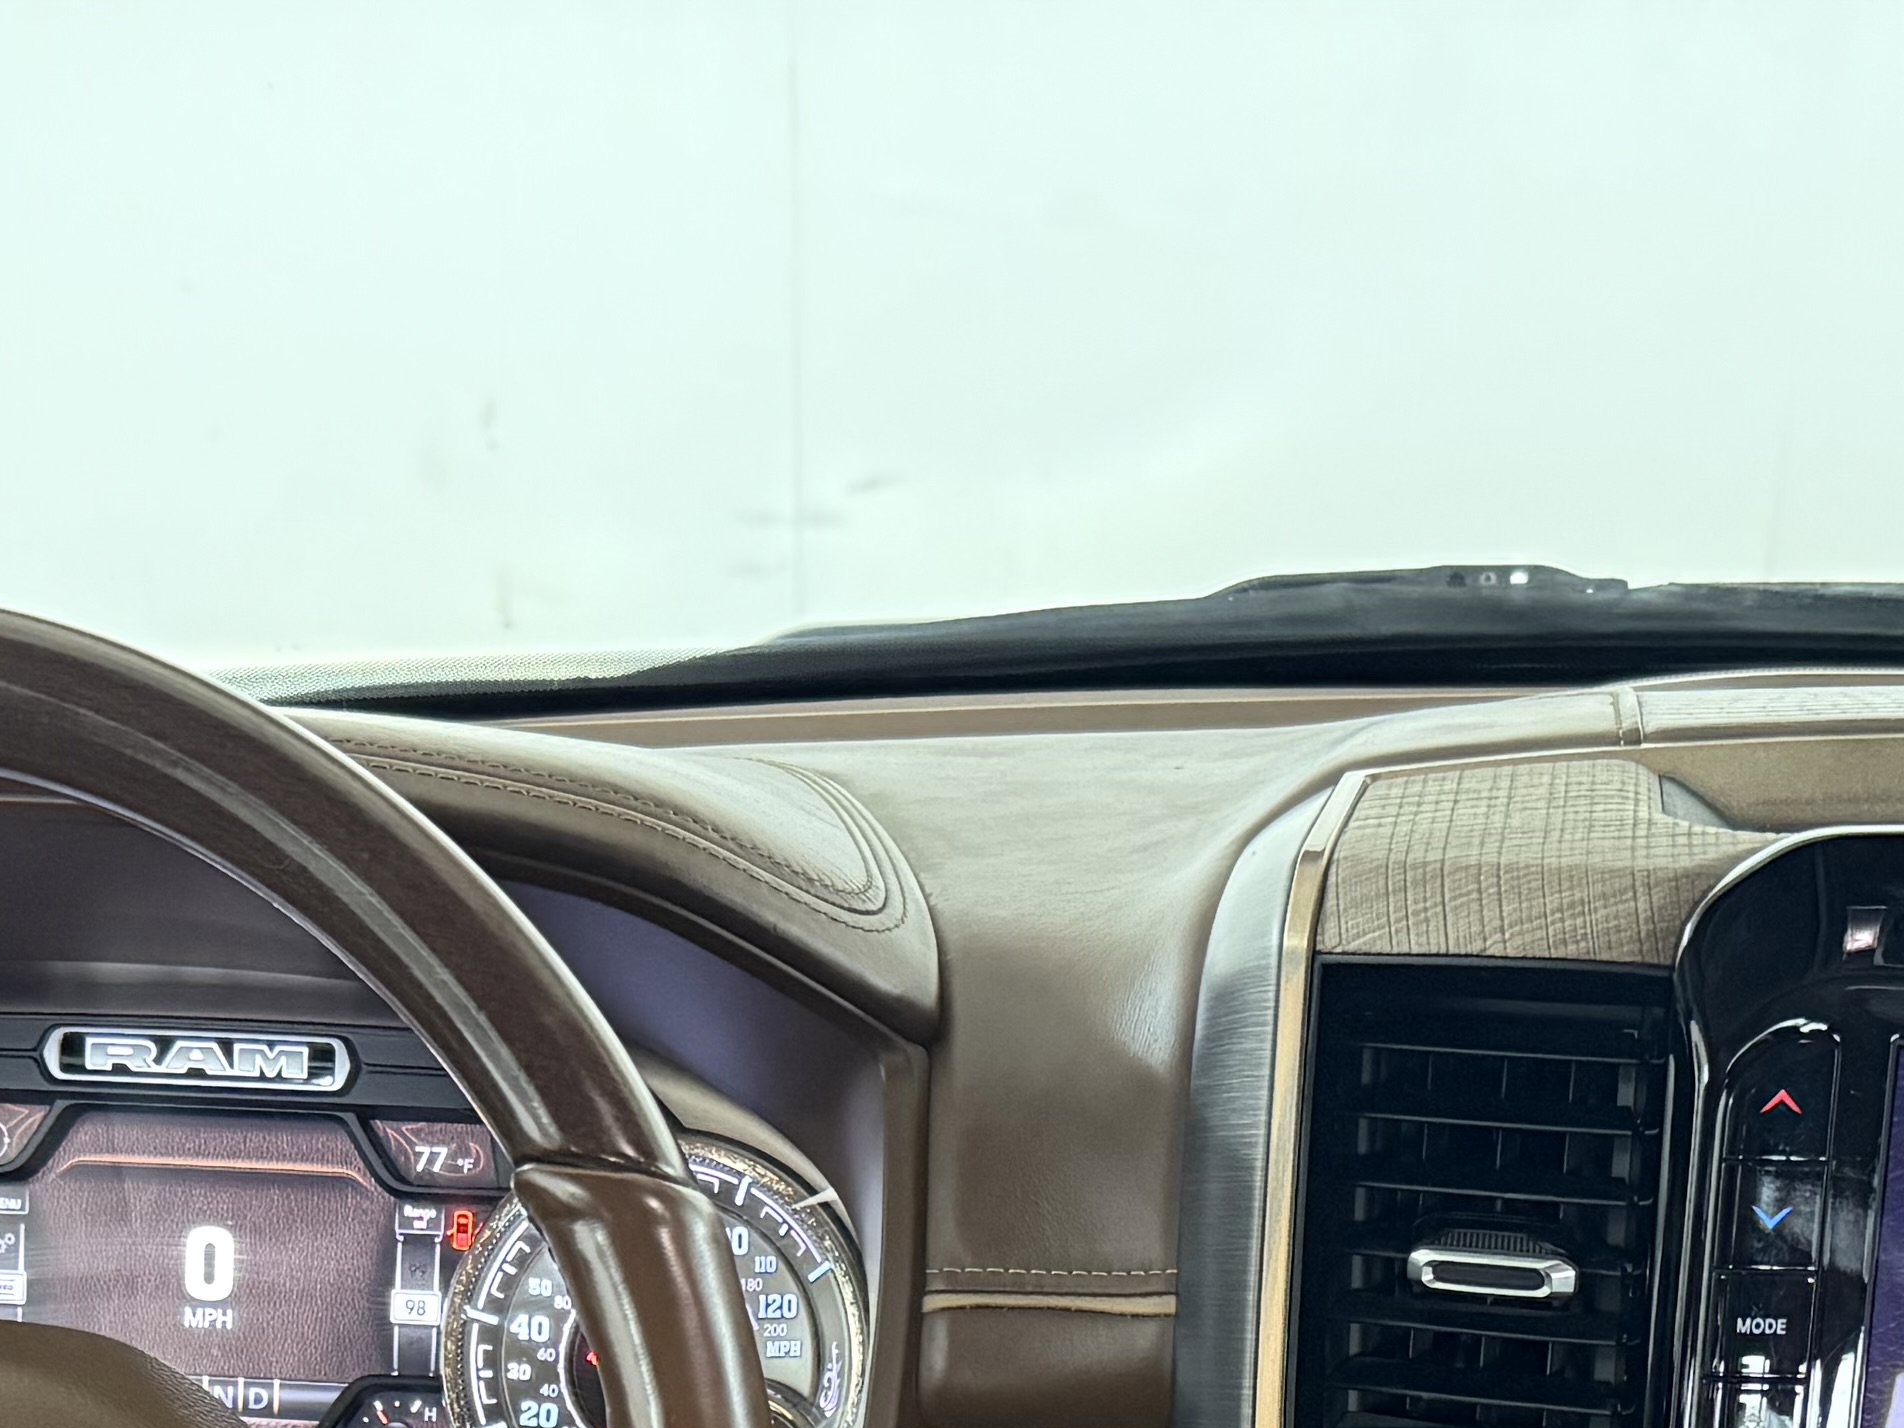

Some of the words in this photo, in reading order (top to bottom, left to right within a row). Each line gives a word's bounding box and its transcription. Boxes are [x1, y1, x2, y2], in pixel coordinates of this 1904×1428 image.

[85, 1036, 309, 1080] RAM
[414, 1145, 449, 1173] 77
[184, 1225, 236, 1302] 0
[753, 1255, 777, 1273] 110
[528, 1277, 553, 1298] 50
[404, 1299, 427, 1317] 98
[757, 1294, 798, 1319] 120
[183, 1305, 234, 1330] MPH
[1735, 1316, 1787, 1336] MODE
[509, 1313, 550, 1343] 40
[763, 1323, 787, 1338] 200
[536, 1347, 556, 1362] 60
[765, 1340, 801, 1358] MPH
[506, 1363, 532, 1381] 30
[212, 1385, 234, 1409] N
[247, 1387, 269, 1410] D
[539, 1384, 559, 1398] 40
[423, 1406, 437, 1423] H
[519, 1401, 560, 1428] 20
